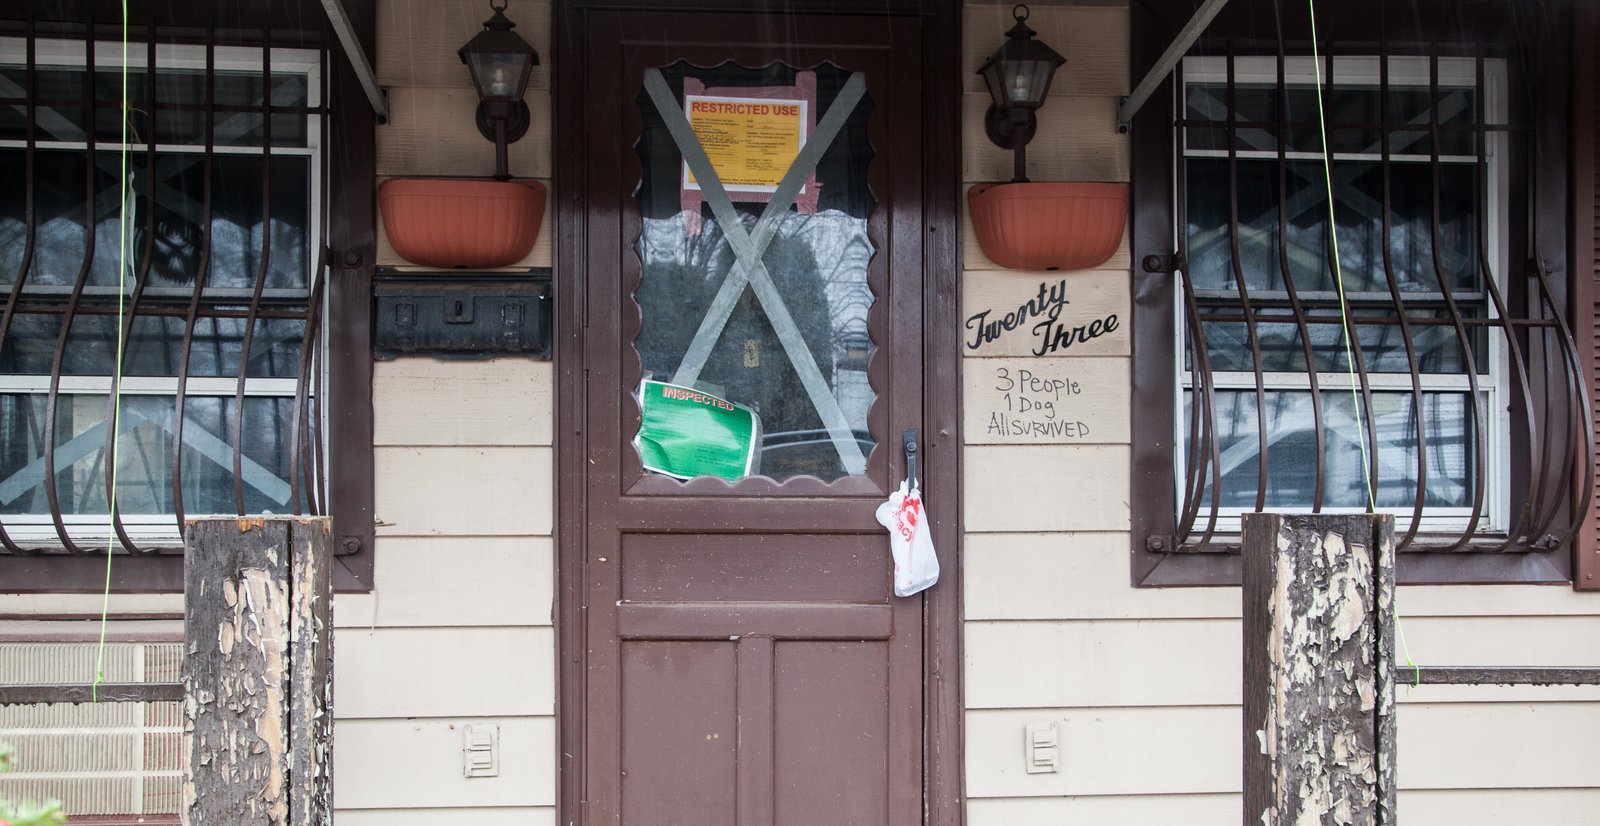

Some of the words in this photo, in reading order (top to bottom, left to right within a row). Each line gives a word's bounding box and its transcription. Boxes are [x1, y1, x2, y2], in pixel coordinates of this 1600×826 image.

[692, 102, 769, 115] RESTRICTED
[773, 105, 797, 116] USE
[966, 280, 1069, 350] Twenty
[1032, 314, 1119, 356] Three
[663, 387, 734, 411] INSPECTED
[996, 367, 1014, 391] 3
[1018, 369, 1081, 401] People
[1004, 393, 1012, 411] 1
[1019, 396, 1055, 419] Dog
